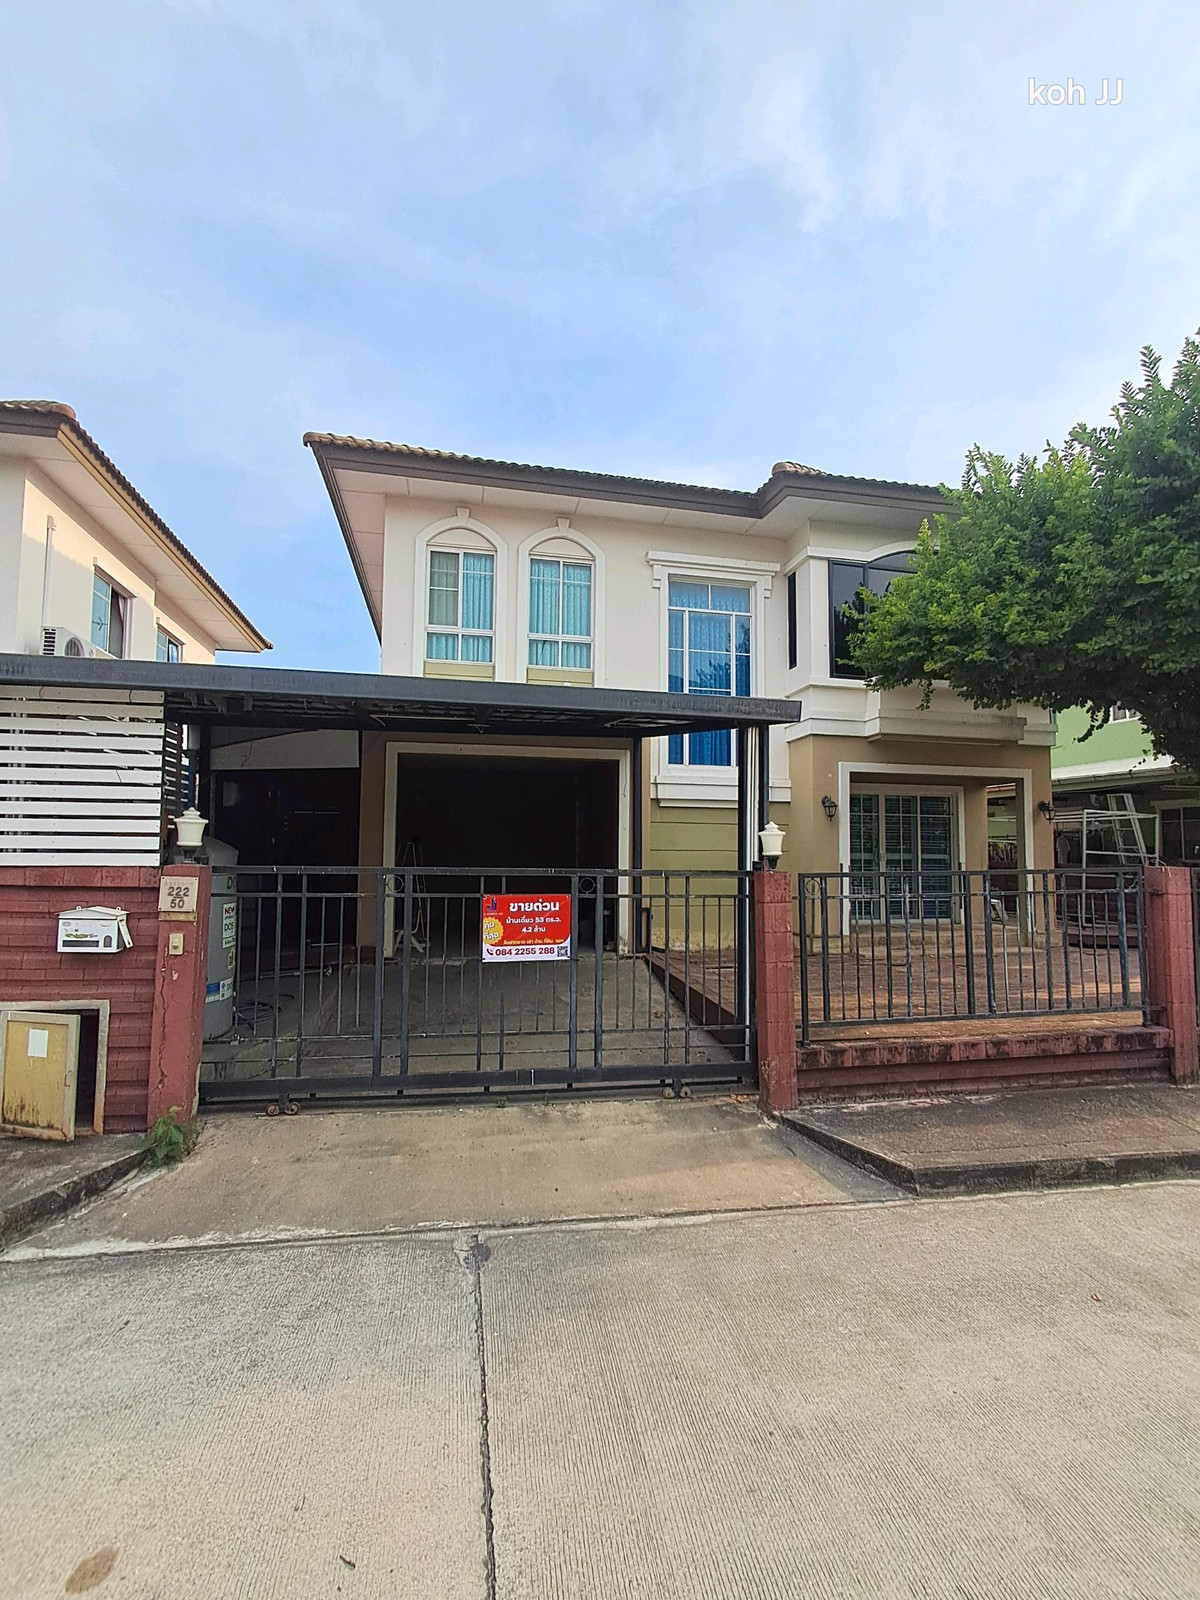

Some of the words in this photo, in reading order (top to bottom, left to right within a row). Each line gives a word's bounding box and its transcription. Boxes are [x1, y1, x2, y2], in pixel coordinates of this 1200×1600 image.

[167, 886, 190, 897] 222
[170, 898, 185, 909] 50
[509, 898, 559, 911] ขายด่วน
[506, 915, 534, 924] บ้านเดี่ยว
[533, 925, 546, 933] ล้าน
[495, 948, 512, 956] 084
[538, 947, 555, 955] 288
